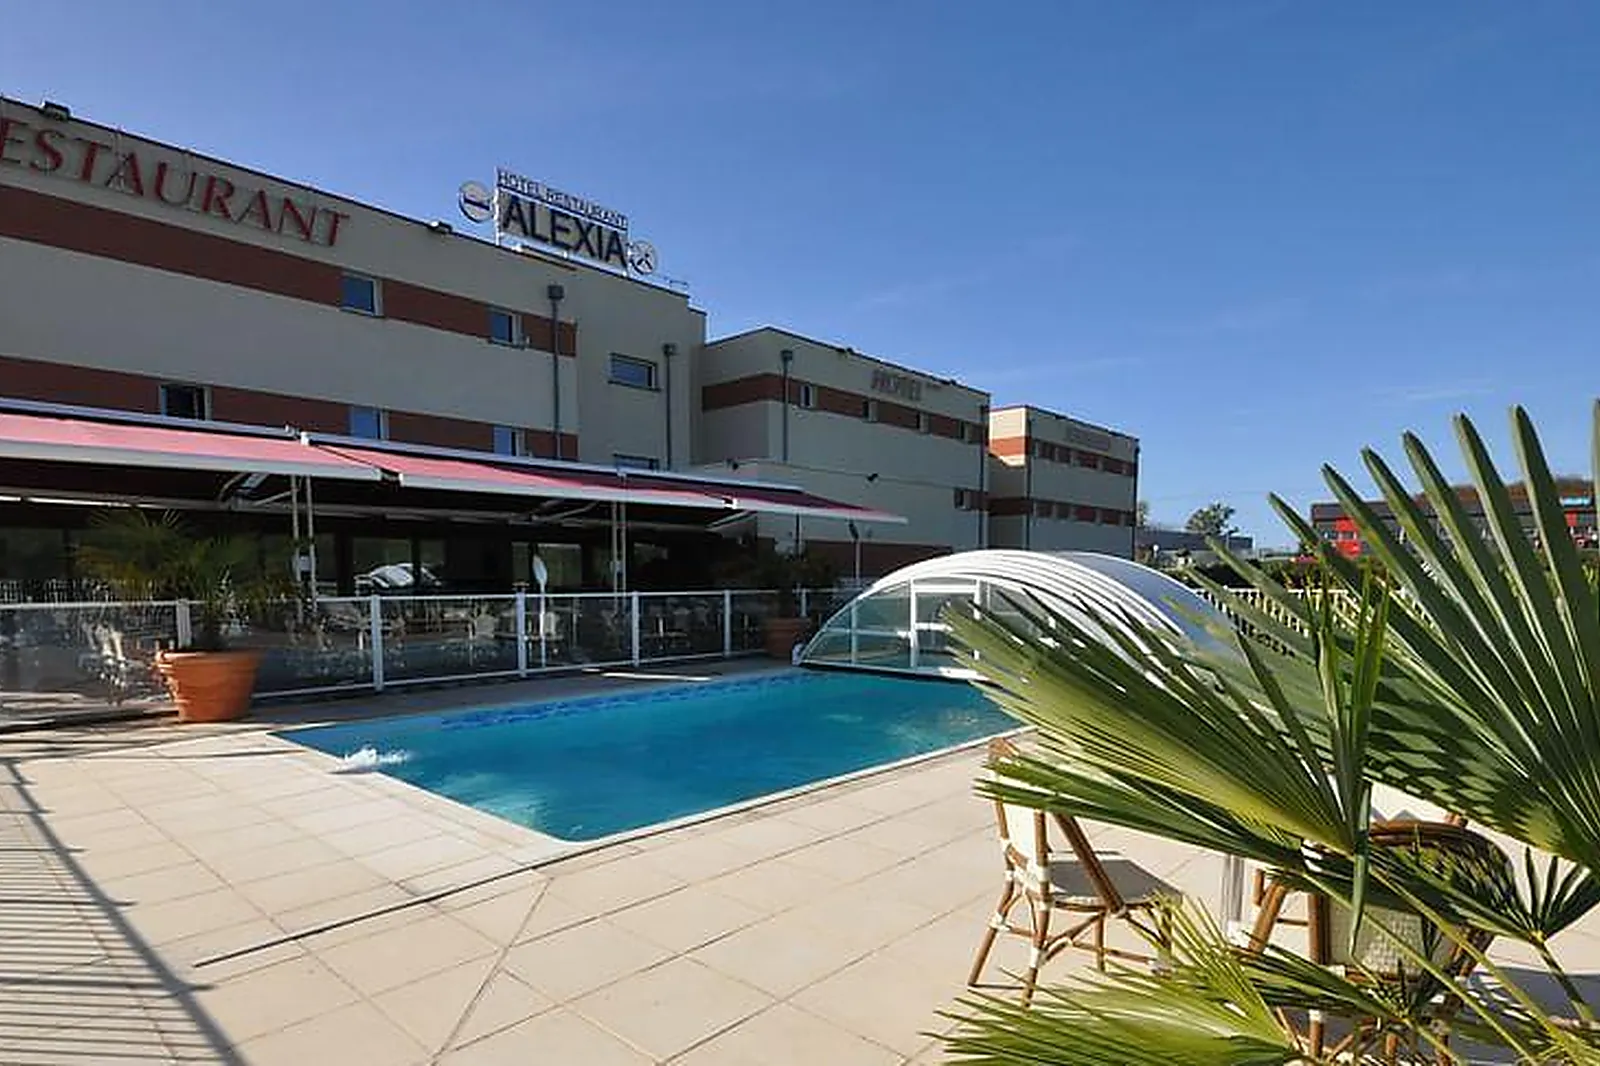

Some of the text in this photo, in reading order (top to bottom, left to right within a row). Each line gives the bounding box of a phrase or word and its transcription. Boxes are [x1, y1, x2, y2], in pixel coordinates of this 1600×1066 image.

[0, 116, 350, 246] ESTAURANT
[498, 170, 627, 227] HOTEL RESTAURANT
[503, 194, 627, 269] ALEXIA
